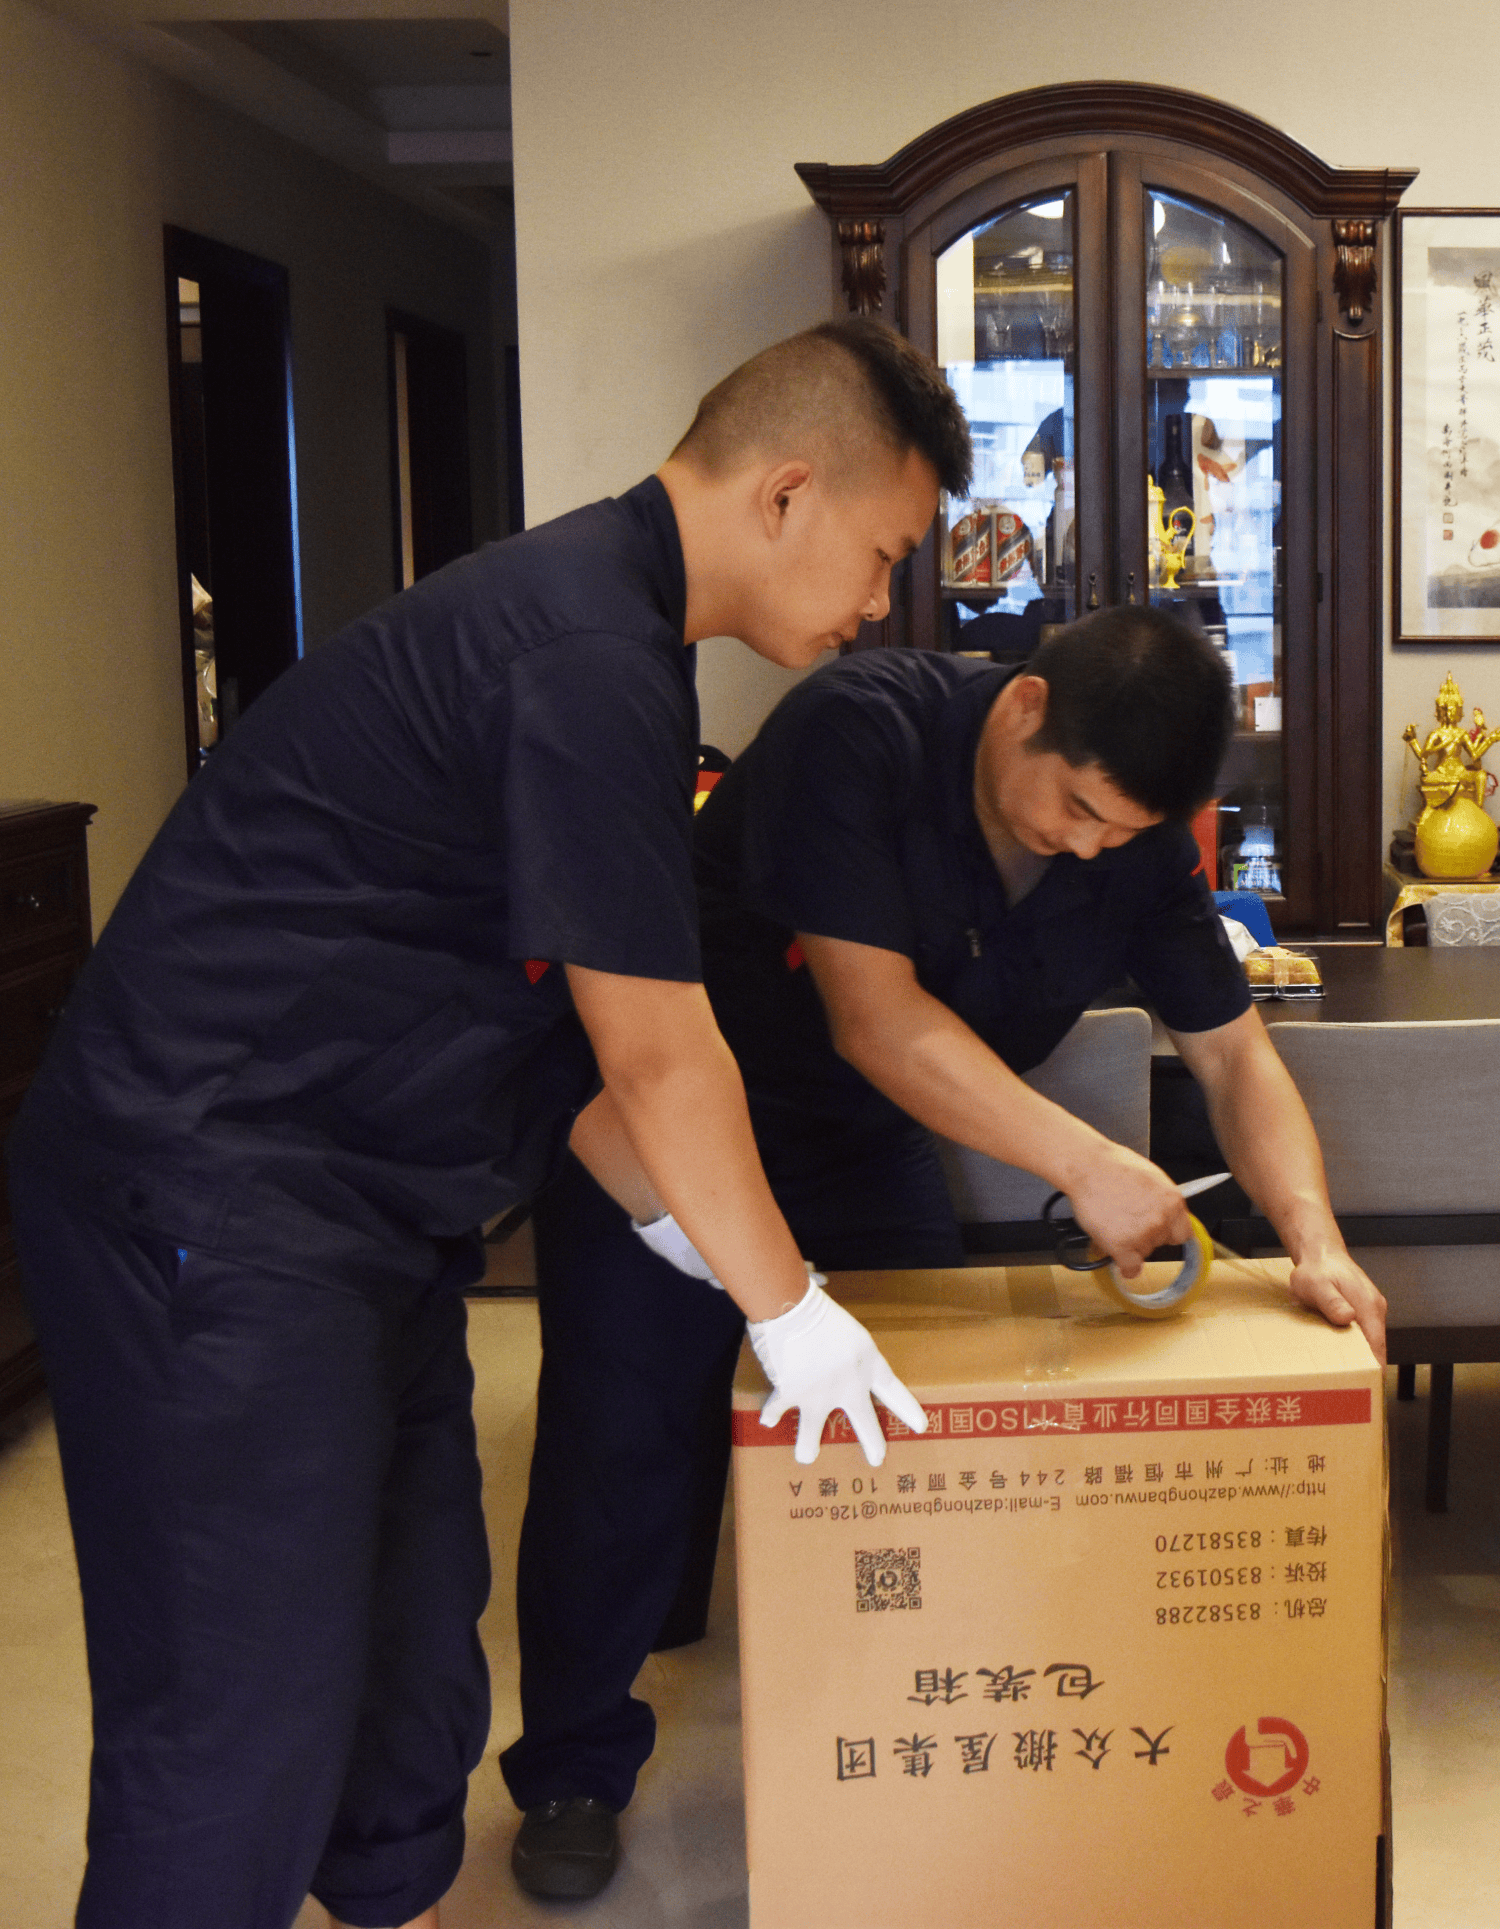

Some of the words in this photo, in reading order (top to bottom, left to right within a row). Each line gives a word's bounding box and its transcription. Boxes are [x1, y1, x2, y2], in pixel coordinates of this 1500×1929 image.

[789, 1495, 1061, 1521] E-mail:dazhongbanwu@126.com
[1075, 1480, 1326, 1506] http://www.dazhongbanwu.com
[906, 1662, 1104, 1706] 包装箱
[835, 1726, 1174, 1783] 大众搬屋集团
